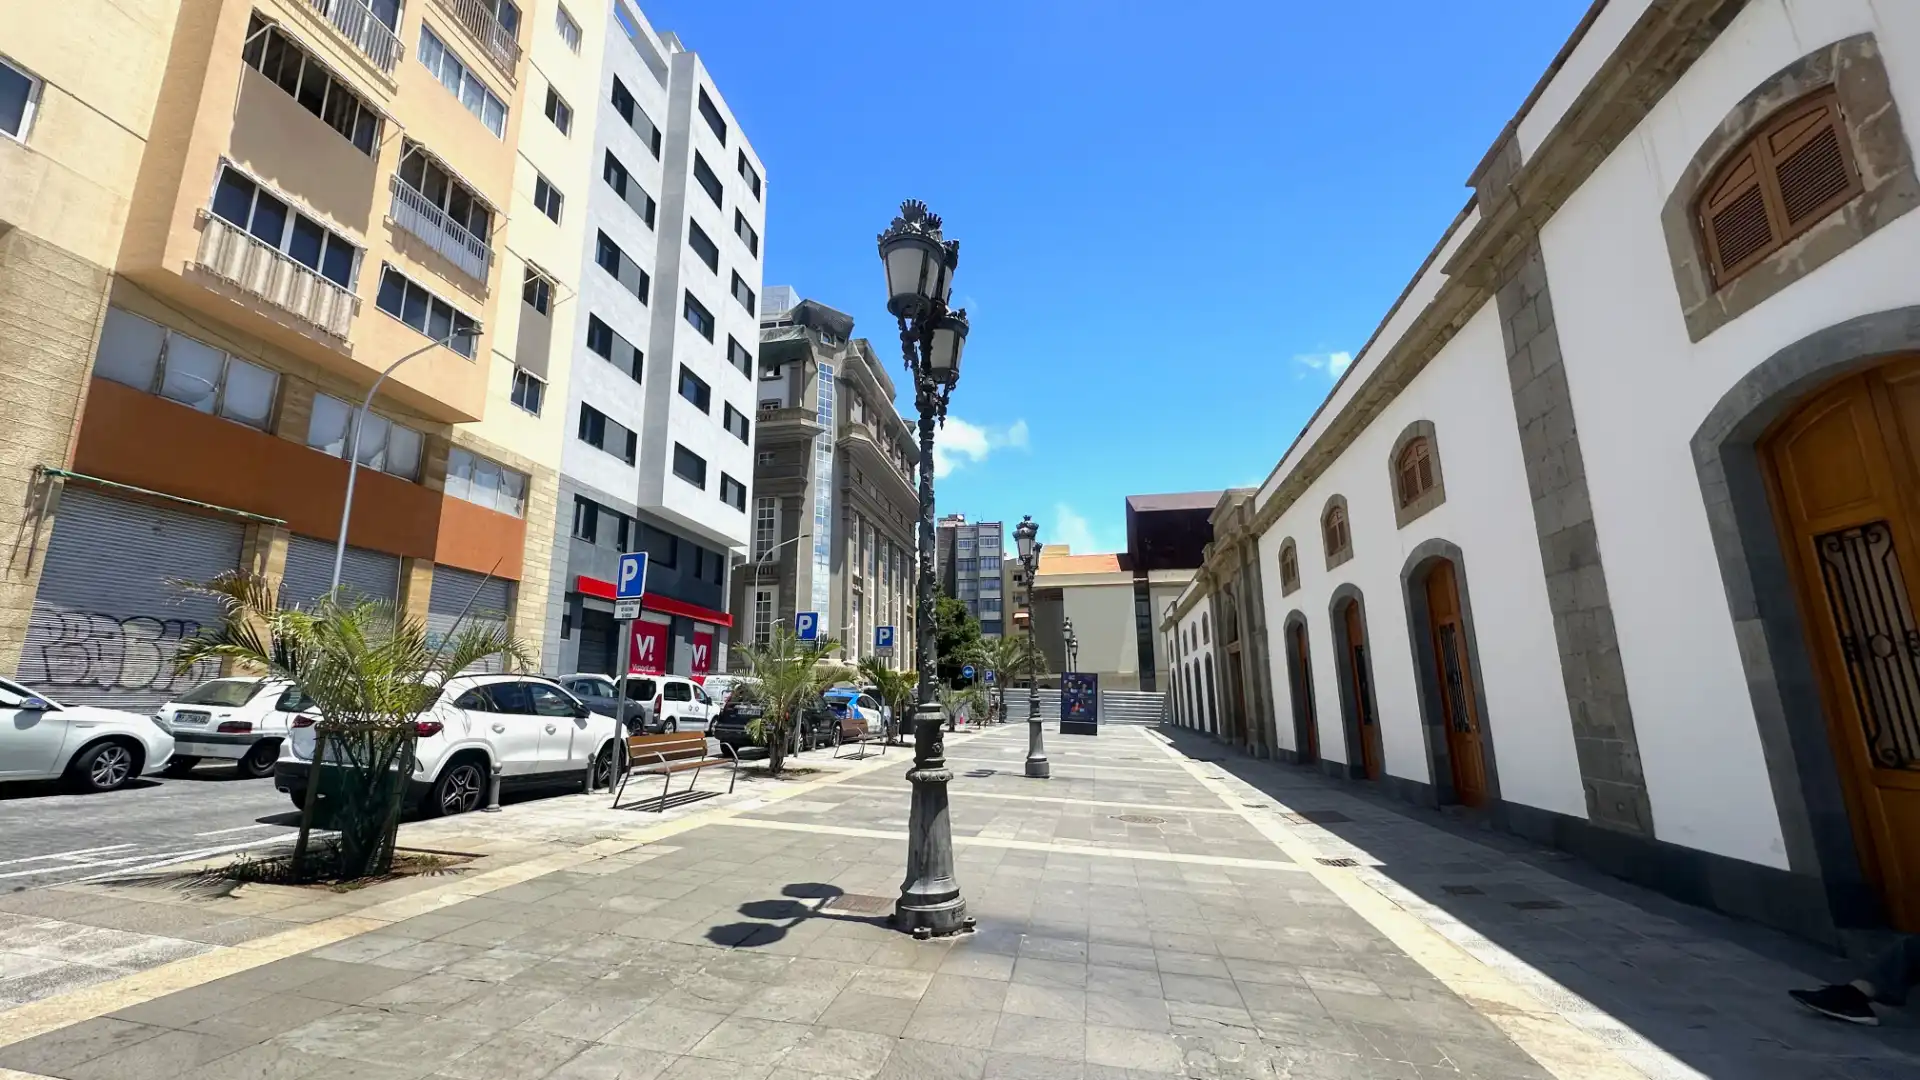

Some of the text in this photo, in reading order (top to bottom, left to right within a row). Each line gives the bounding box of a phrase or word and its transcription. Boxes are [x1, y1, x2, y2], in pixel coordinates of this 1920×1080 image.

[620, 558, 638, 593] P
[797, 615, 813, 637] P
[879, 628, 890, 645] P
[985, 671, 993, 680] P
